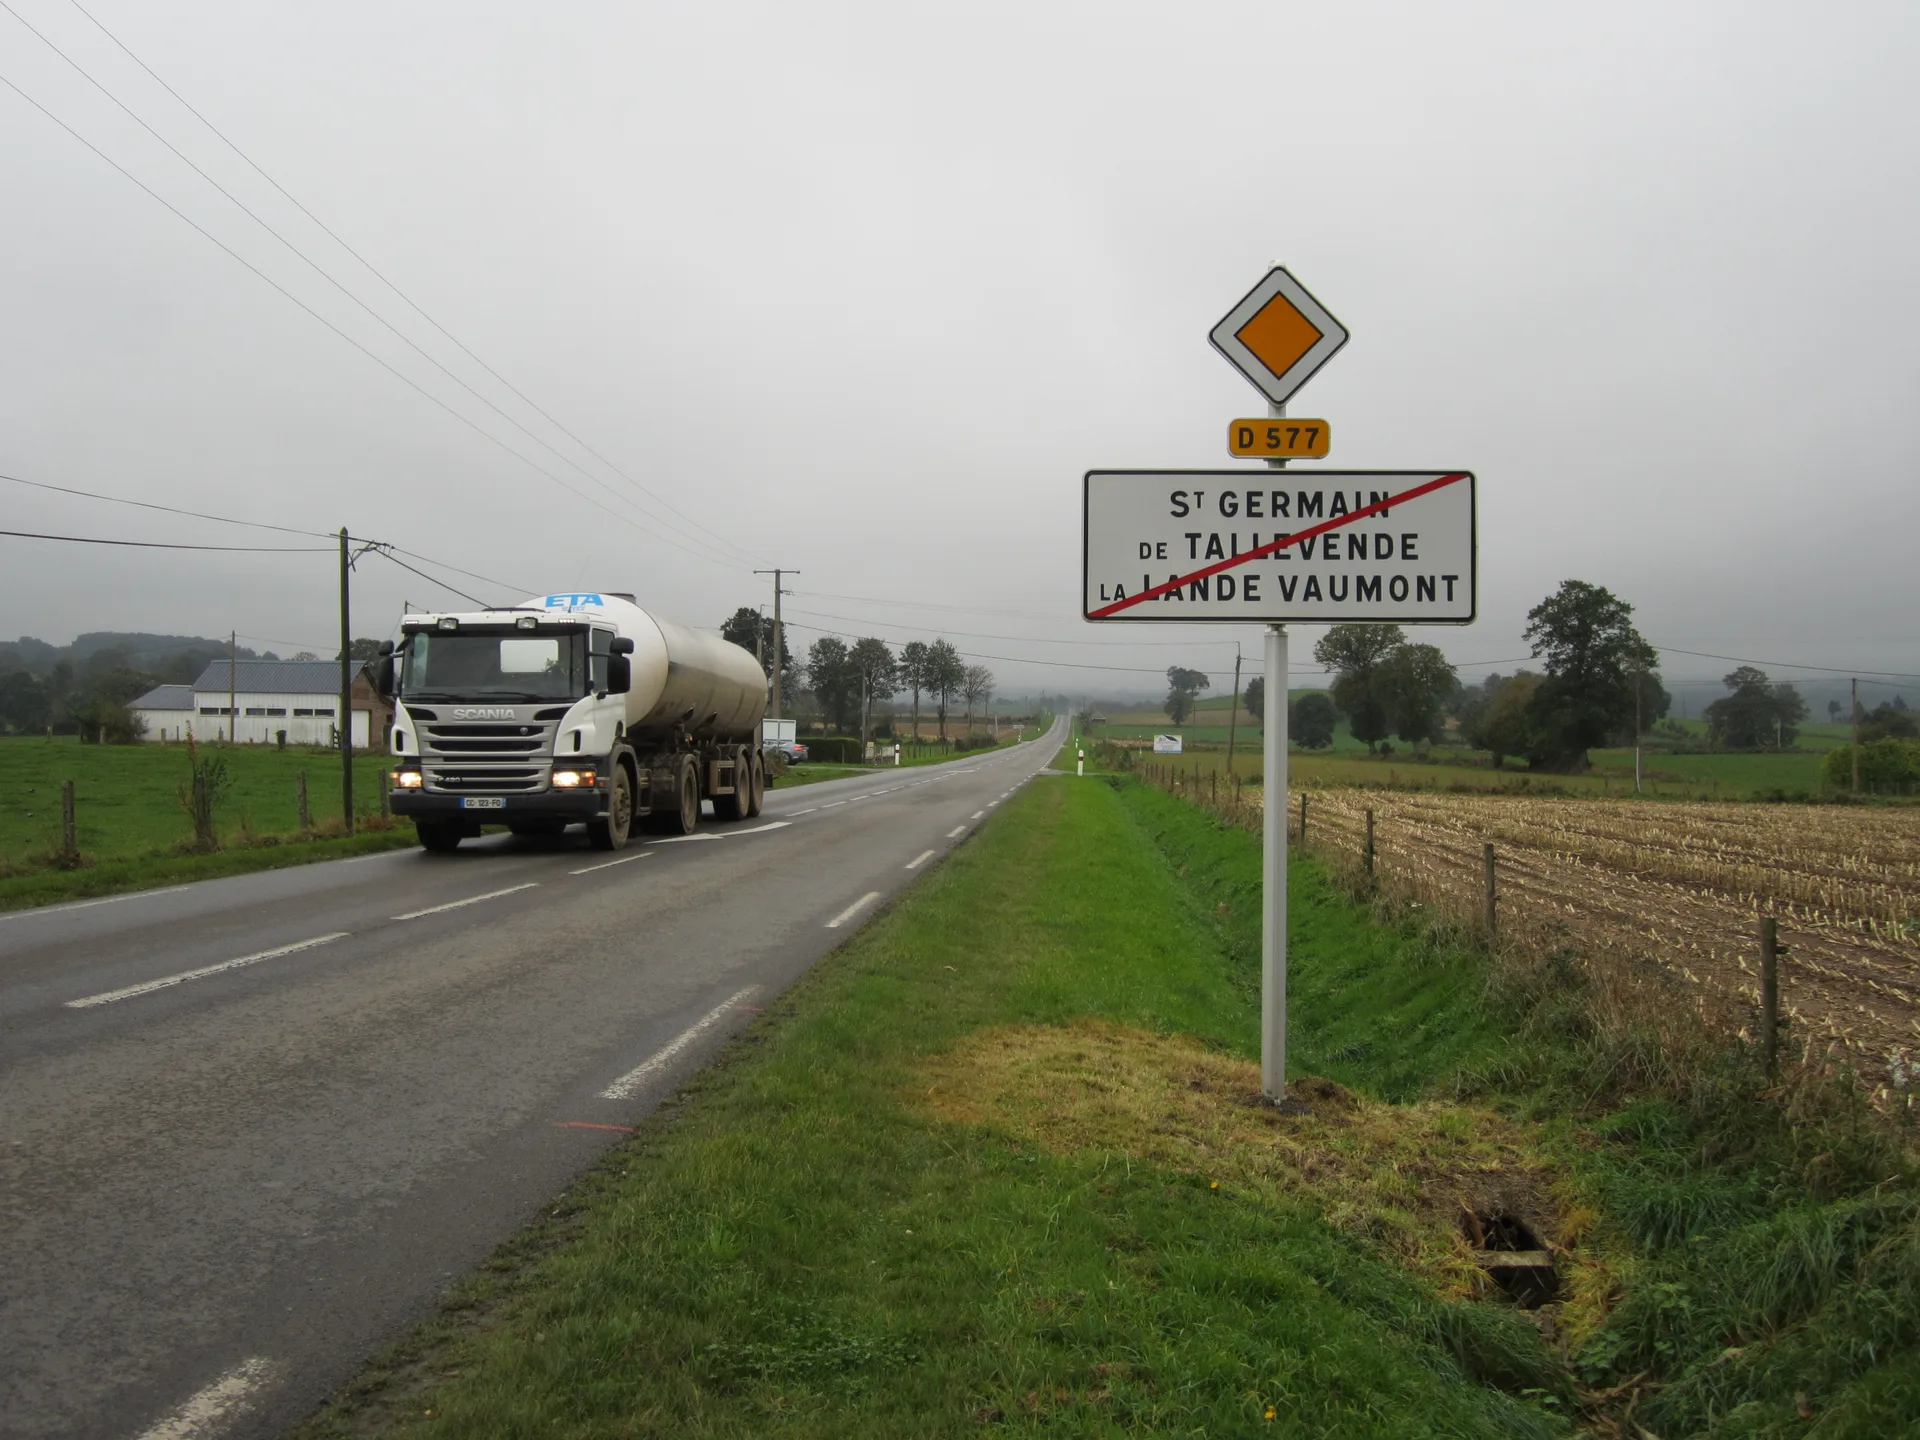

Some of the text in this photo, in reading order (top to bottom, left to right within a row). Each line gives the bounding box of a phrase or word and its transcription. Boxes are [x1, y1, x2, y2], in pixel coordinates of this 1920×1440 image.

[1238, 427, 1319, 449] D 577
[1218, 490, 1390, 518] GERMAIN
[1139, 532, 1419, 561] DE TALLEVENDE
[545, 594, 604, 607] ETA
[1100, 574, 1459, 603] LA LANDE VAUMONT
[453, 708, 517, 720] SCANIA
